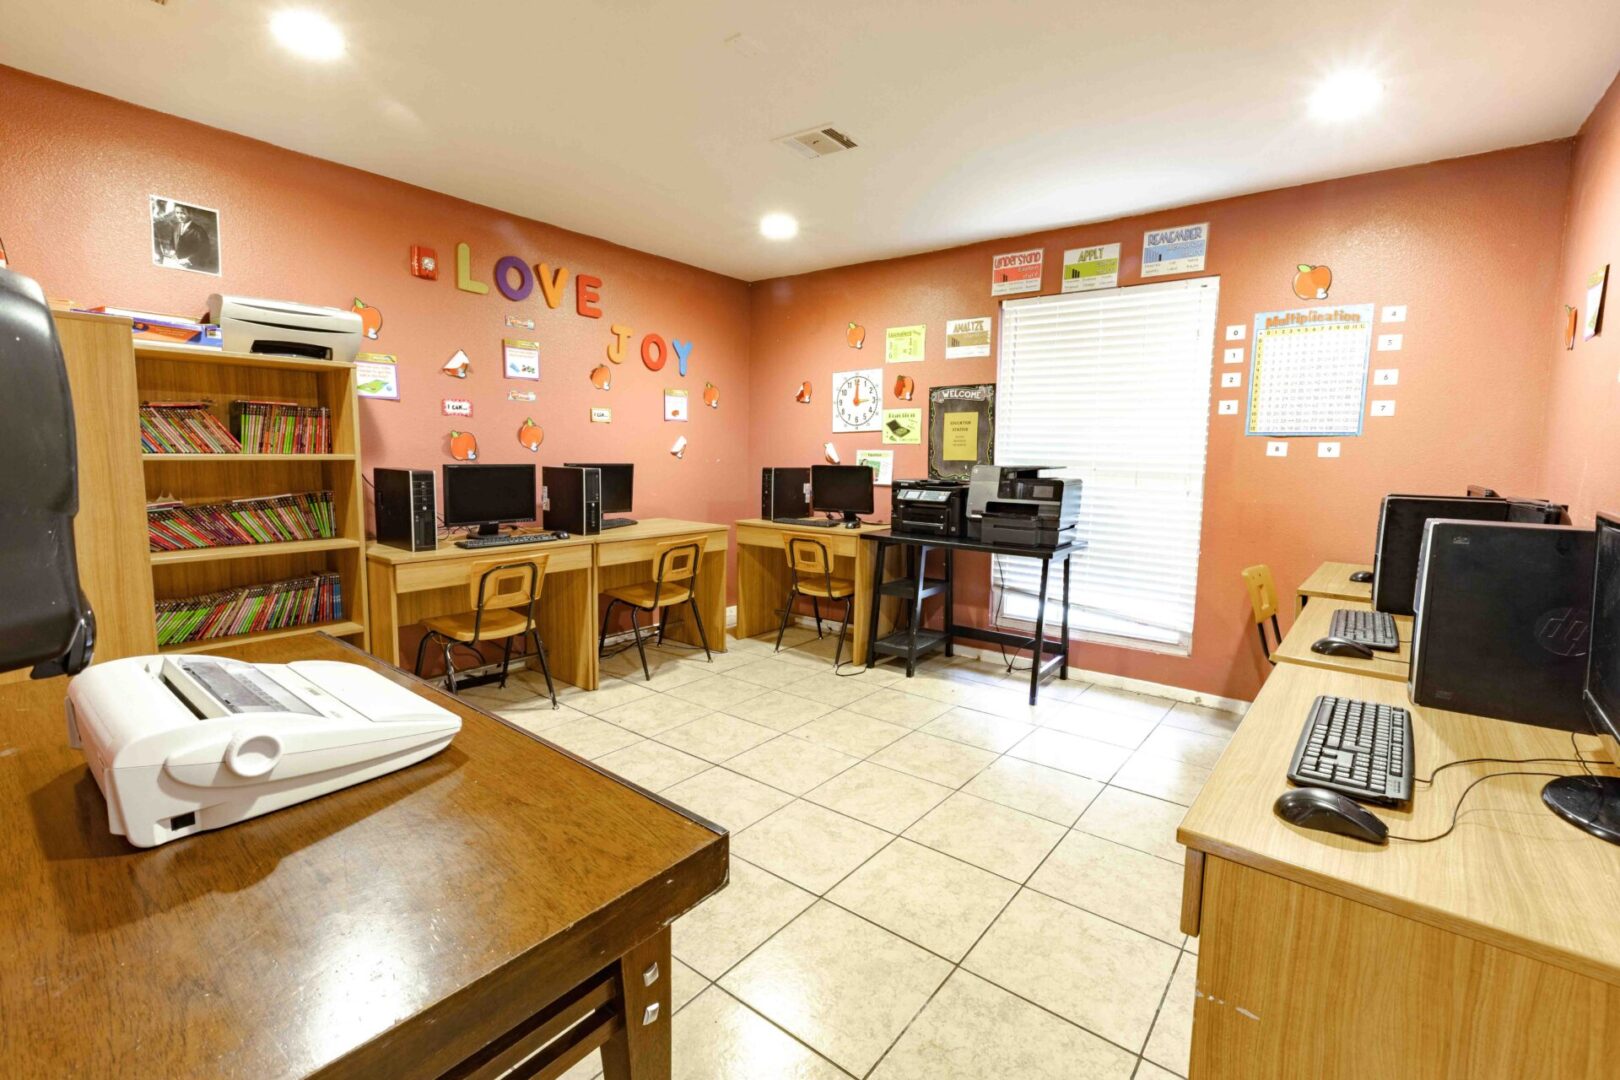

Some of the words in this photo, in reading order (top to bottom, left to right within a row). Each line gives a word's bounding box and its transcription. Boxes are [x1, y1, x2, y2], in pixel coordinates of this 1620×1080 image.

[1147, 226, 1202, 246] REMEMBER
[1078, 247, 1105, 262] APPLY
[456, 242, 603, 319] LOVE
[953, 320, 985, 334] ANALYZE
[1265, 309, 1361, 329] Multiplication
[607, 323, 694, 377] JOY
[942, 390, 982, 399] WELCOME
